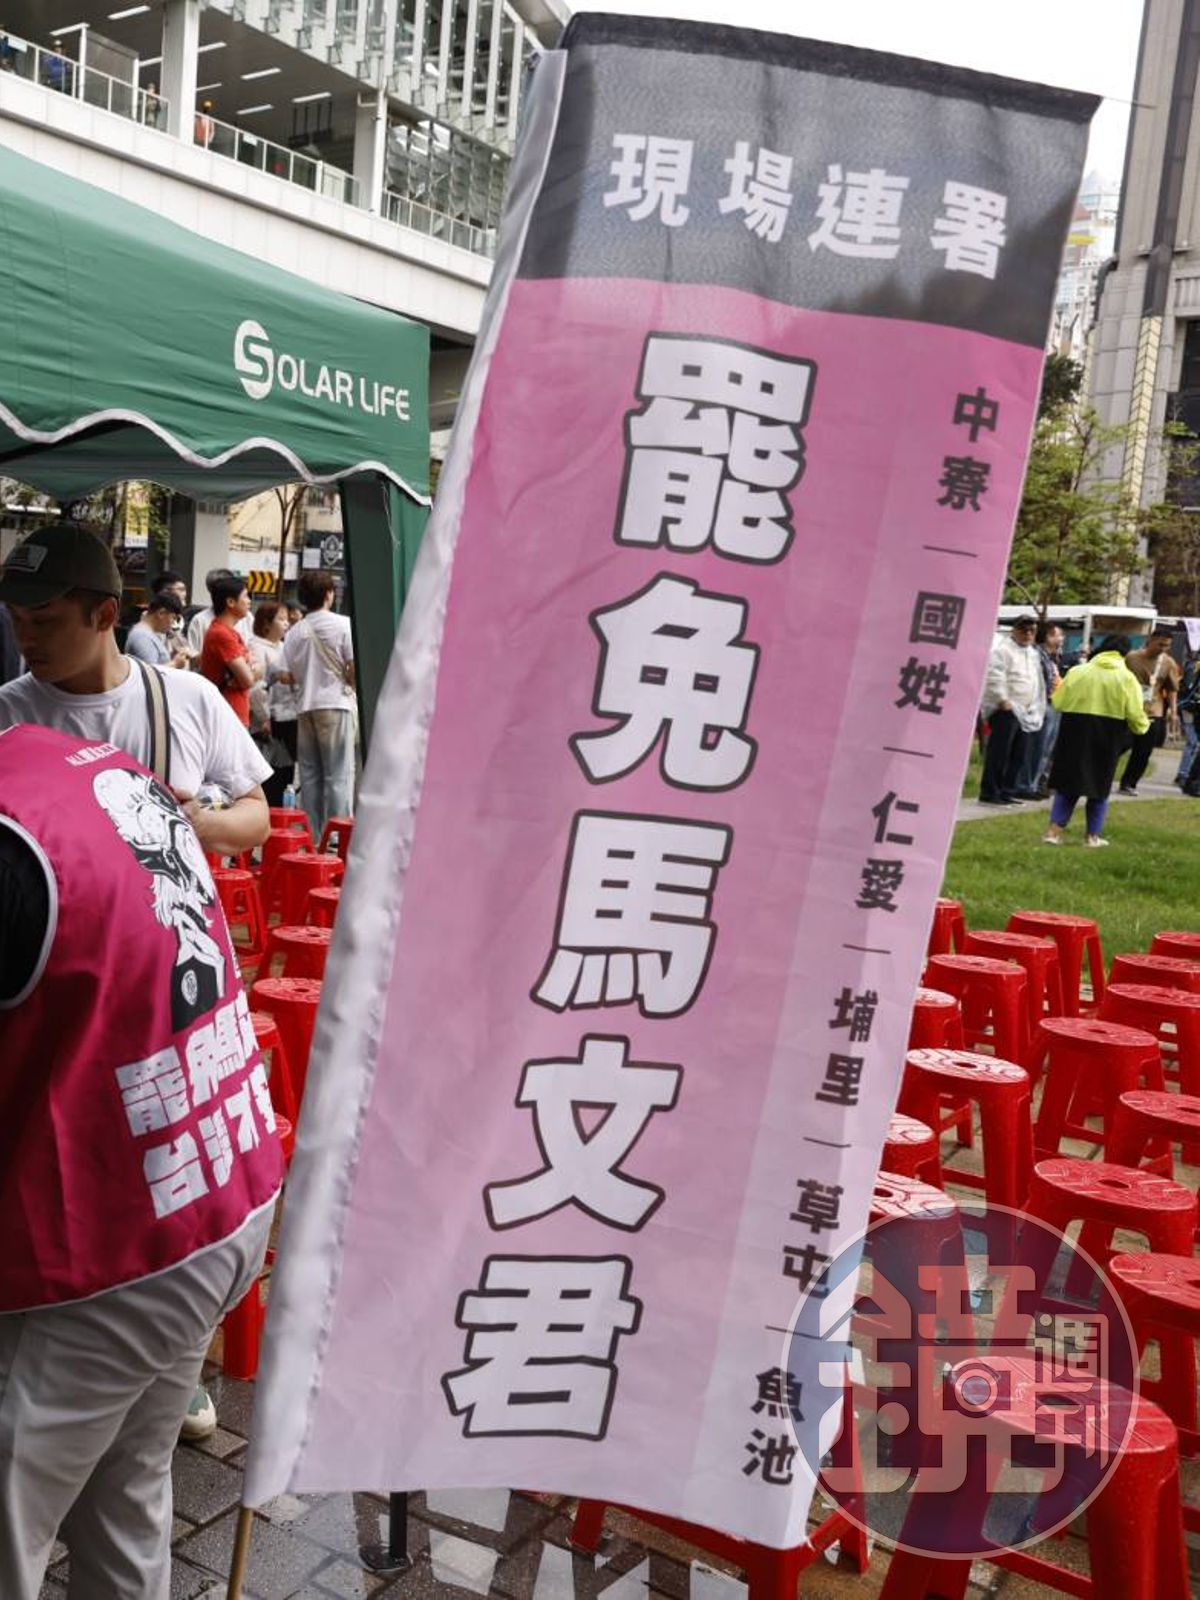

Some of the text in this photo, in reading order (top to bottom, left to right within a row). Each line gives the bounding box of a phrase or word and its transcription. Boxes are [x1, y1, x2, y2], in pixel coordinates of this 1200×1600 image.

[234, 319, 410, 421] SOLAR LIFE
[603, 133, 1007, 280] 現場連署
[441, 331, 818, 1441] 罷免馬文君
[741, 386, 1000, 1486] 中寮 國姓 仁愛 埔里 草屯 魚池
